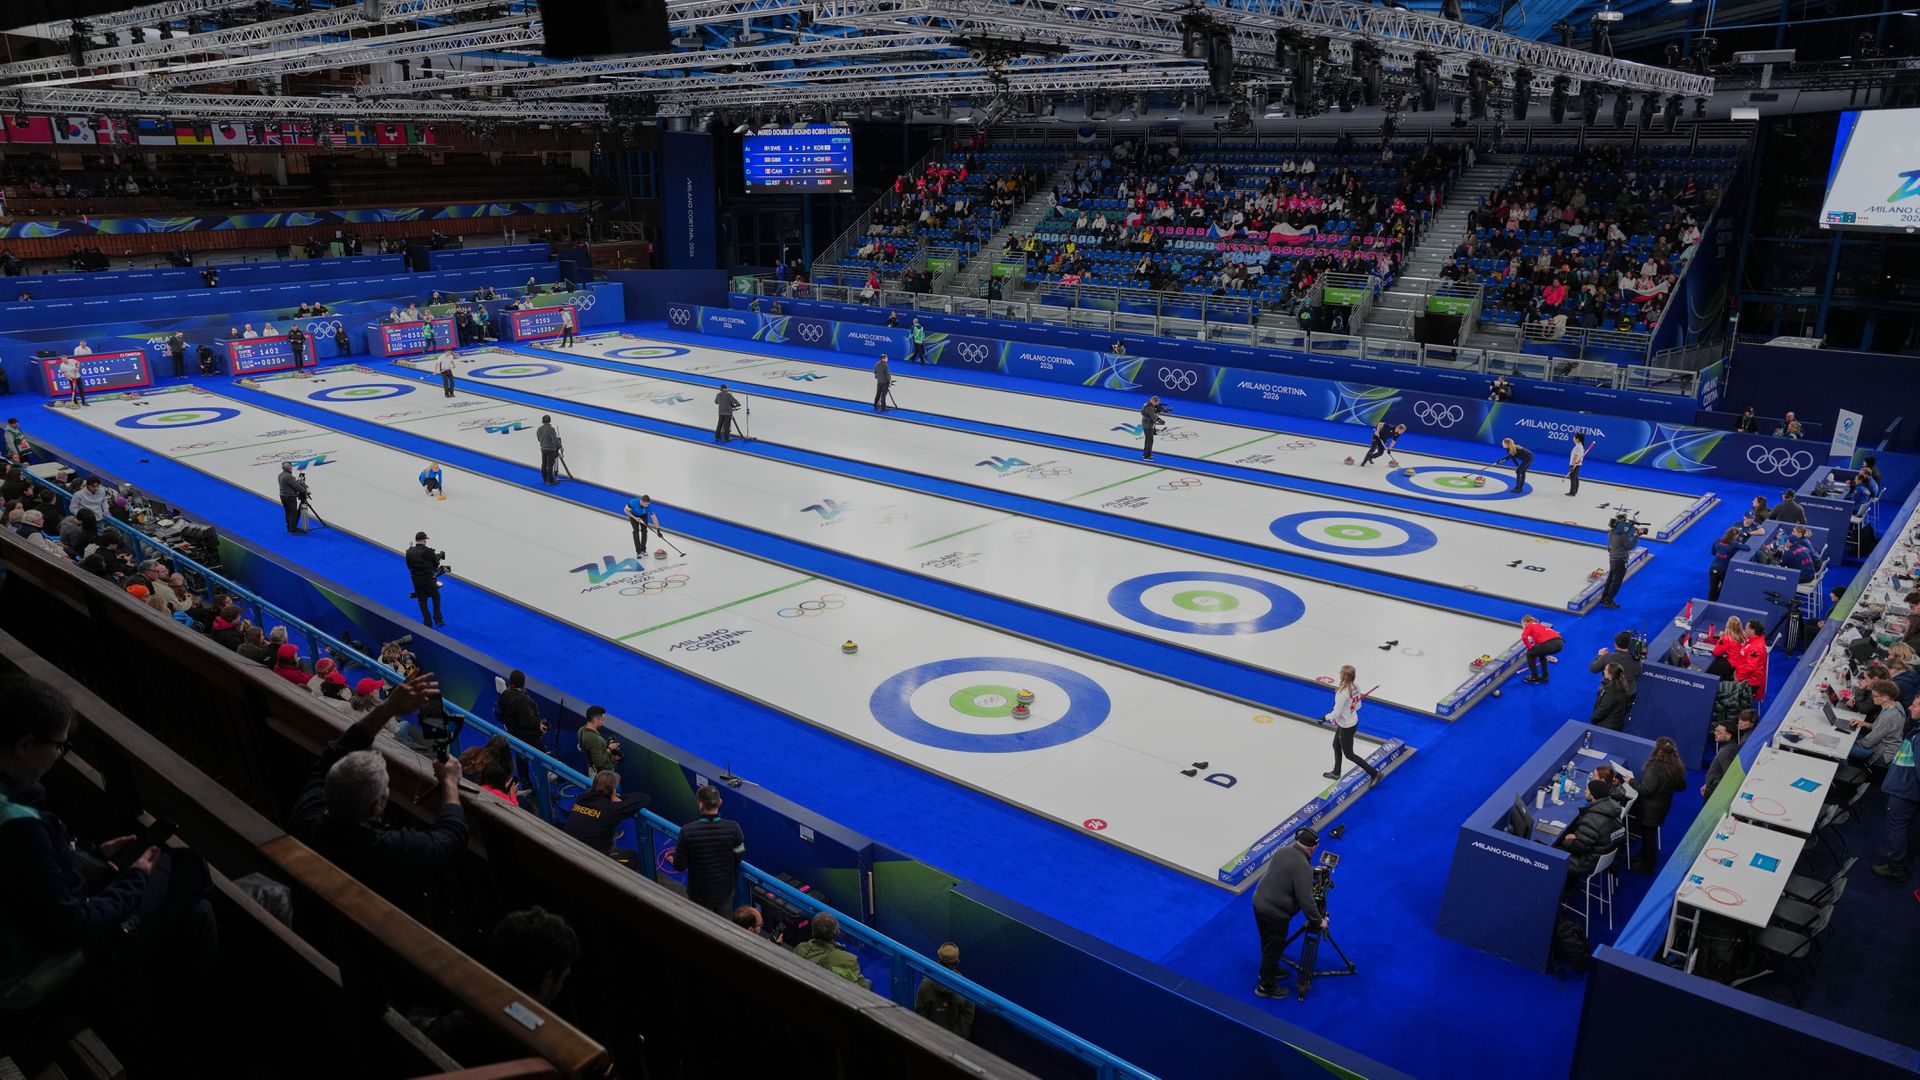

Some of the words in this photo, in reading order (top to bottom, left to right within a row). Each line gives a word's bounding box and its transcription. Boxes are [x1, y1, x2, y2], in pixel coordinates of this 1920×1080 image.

[1864, 206, 1913, 214] MILANO
[710, 315, 727, 323] MILANO
[848, 332, 869, 340] MILANO
[870, 334, 892, 343] CORTINA
[864, 339, 875, 347] 2026
[1020, 353, 1046, 361] MILANO
[1047, 356, 1074, 366] CORTINA
[81, 366, 105, 374] 0100
[84, 377, 108, 386] 1021
[1237, 381, 1270, 391] MILANO
[1272, 385, 1306, 396] CORTINA
[1263, 391, 1279, 400] 2026
[1515, 419, 1558, 430] MILANO
[1560, 423, 1605, 437] CORTINA
[1548, 431, 1569, 440] 2026
[1524, 565, 1546, 573] B
[1755, 571, 1776, 579] CORTINA
[669, 629, 728, 652] MILANO
[686, 630, 752, 651] CORTINA
[707, 640, 740, 652] 2026
[1642, 671, 1667, 681] MILANO
[1667, 676, 1692, 687] CORTINA
[1203, 773, 1237, 789] D
[572, 804, 601, 819] SWEDEN
[1472, 841, 1501, 855] MILANO
[1502, 850, 1532, 865] CORTINA
[1533, 860, 1549, 871] 2026
